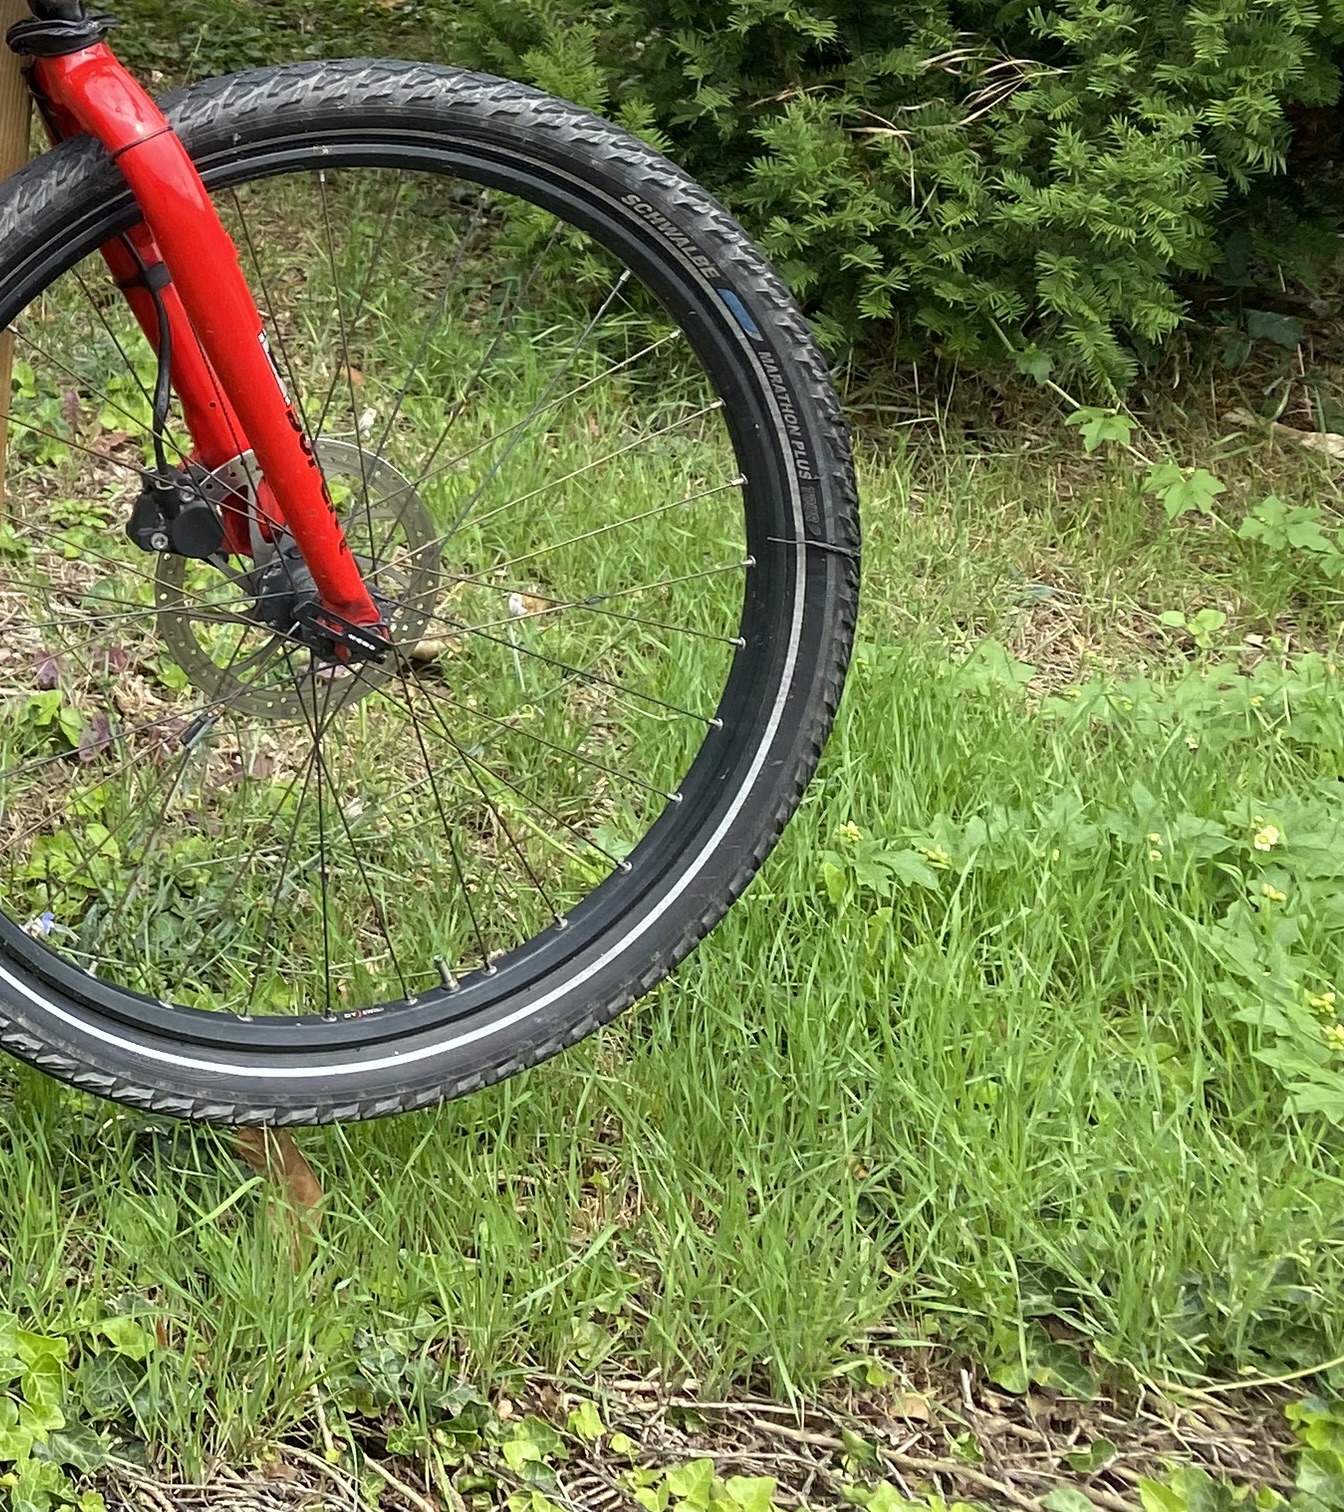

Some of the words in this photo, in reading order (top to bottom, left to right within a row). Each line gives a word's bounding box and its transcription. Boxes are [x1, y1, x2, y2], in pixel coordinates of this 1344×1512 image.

[620, 193, 722, 280] SCHWALBE
[758, 350, 802, 439] MARATHON
[791, 440, 813, 481] PLUS
